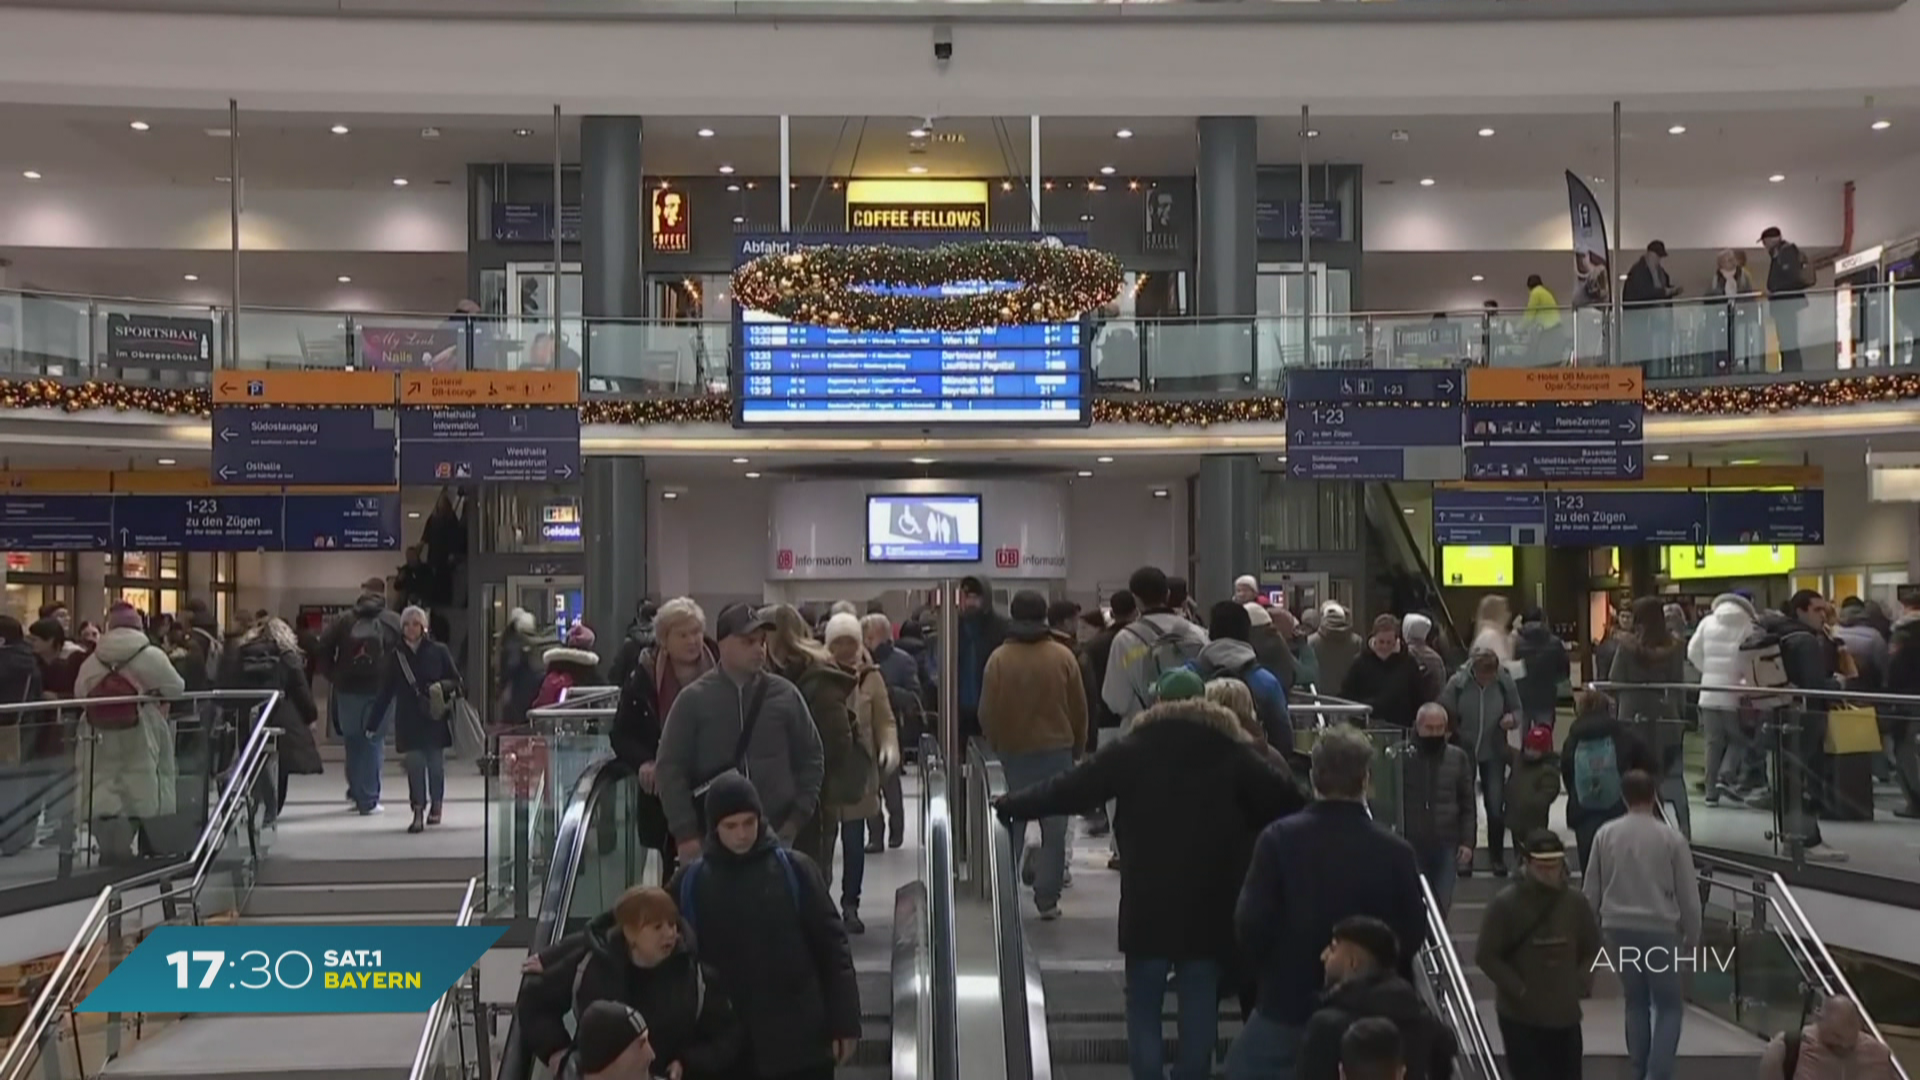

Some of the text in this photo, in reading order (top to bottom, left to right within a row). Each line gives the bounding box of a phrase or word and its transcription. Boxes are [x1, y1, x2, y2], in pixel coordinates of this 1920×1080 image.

[854, 210, 981, 227] COFFEE FELLOWS
[742, 240, 790, 254] Abfahrt
[115, 325, 198, 340] SPORTSBAR
[131, 350, 198, 362] Obergeschoss
[382, 351, 413, 363] Nails
[432, 387, 477, 398] DB-Lounge
[1383, 385, 1403, 395] 1-23
[1312, 409, 1344, 424] 1-23
[251, 421, 318, 434] Südostausgang
[433, 421, 479, 430] Information
[506, 447, 547, 456] Westhalle
[246, 461, 281, 471] Osthalle
[492, 458, 547, 467] Reisezentrum
[186, 499, 217, 514] 1-23
[1554, 495, 1584, 509] 1-23
[186, 515, 261, 529] zu den Zügen
[1554, 511, 1626, 524] zu den Zügen
[998, 551, 1017, 565] DB
